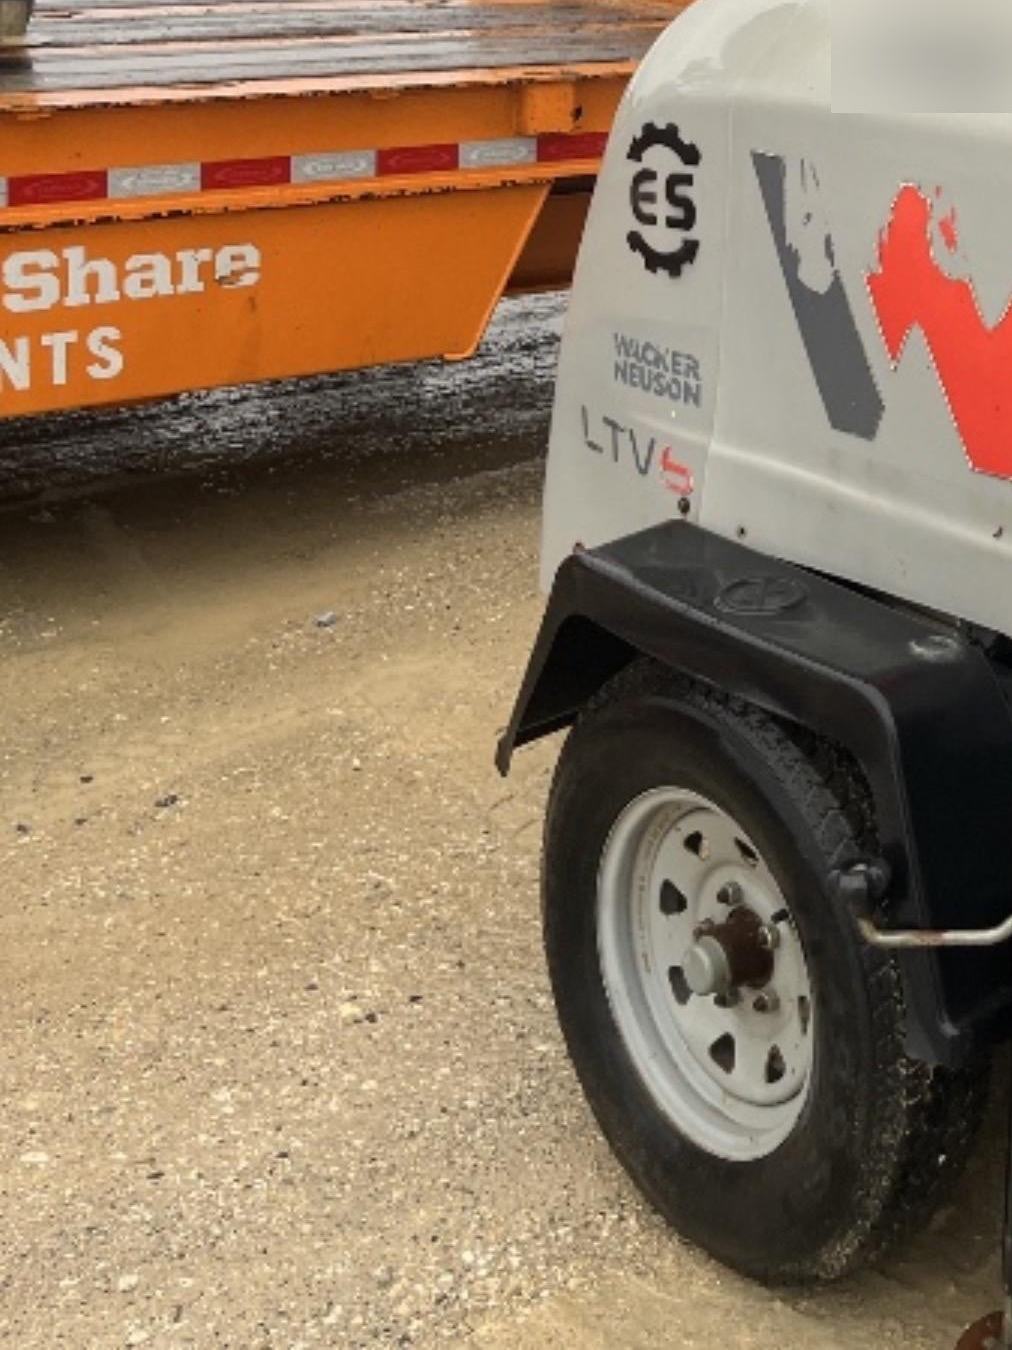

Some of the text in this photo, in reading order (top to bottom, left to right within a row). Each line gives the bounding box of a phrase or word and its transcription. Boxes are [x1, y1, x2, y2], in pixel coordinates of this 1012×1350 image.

[629, 167, 697, 232] ES
[2, 242, 261, 313] Share
[614, 359, 702, 408] NEUSON
